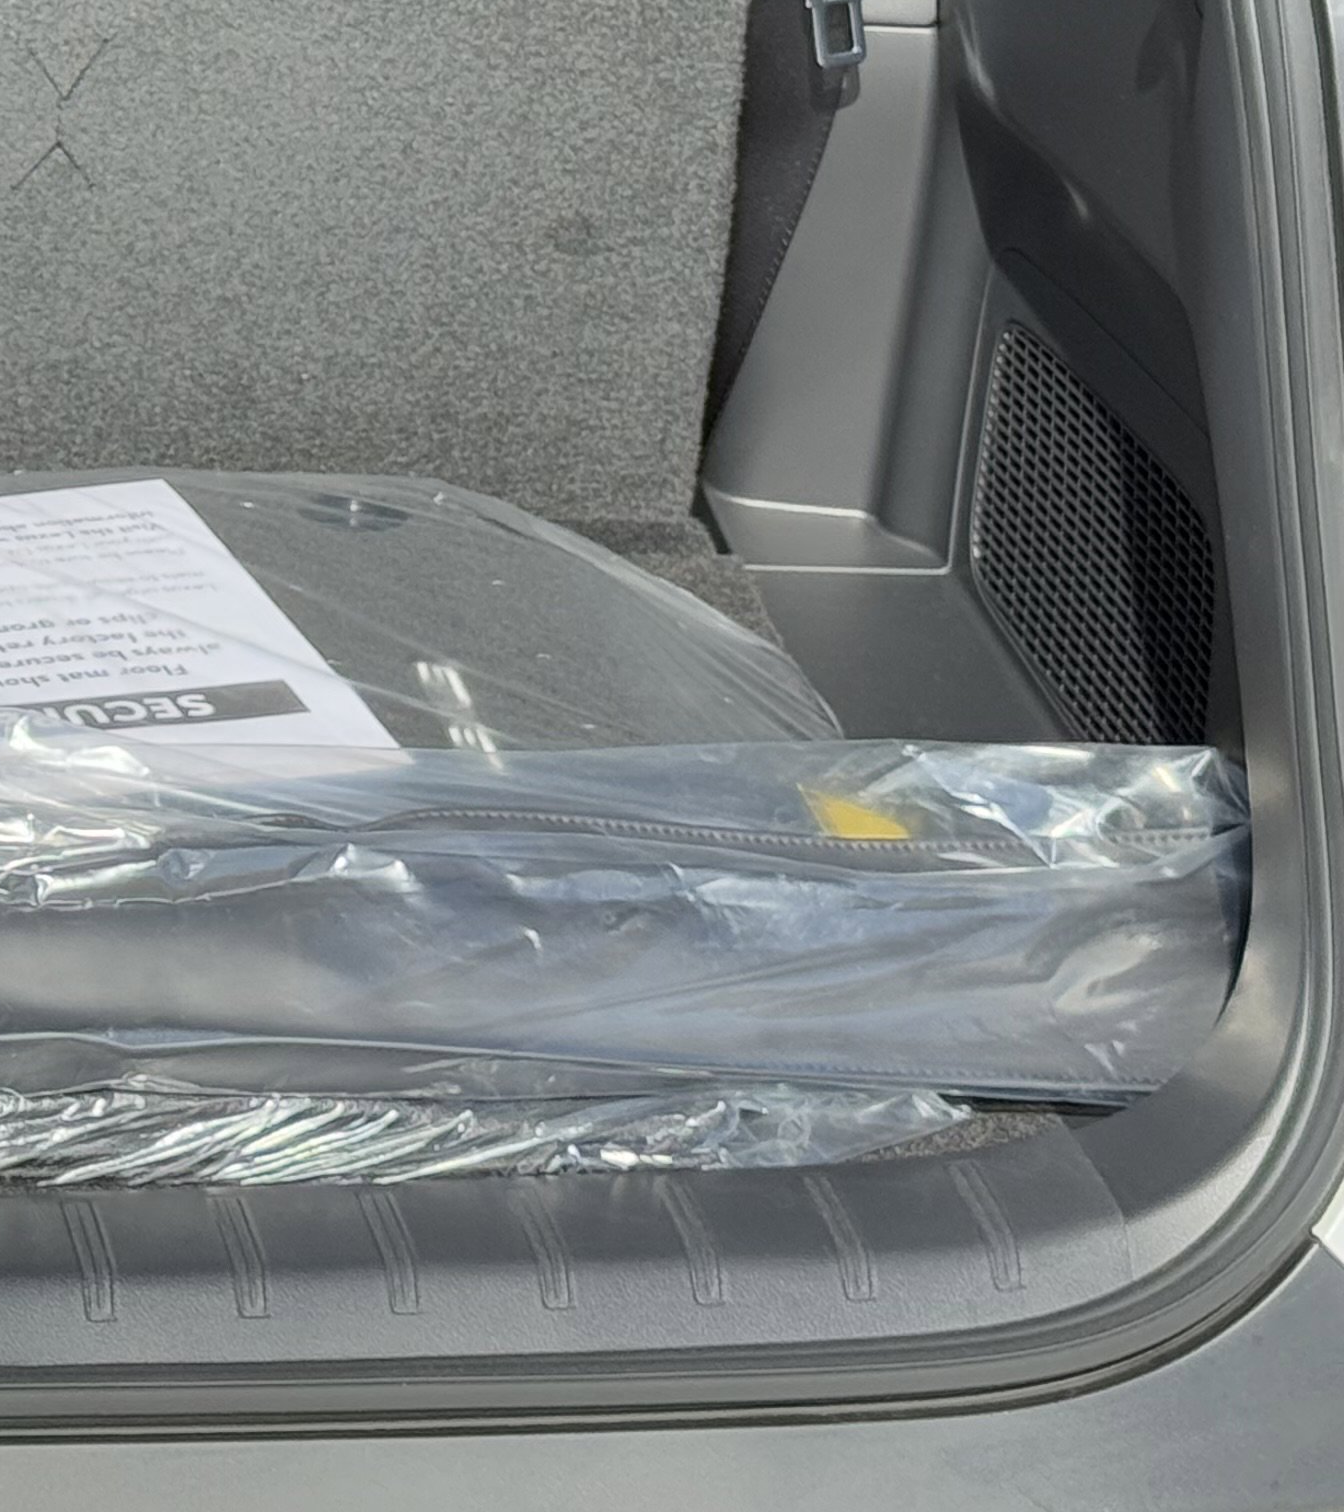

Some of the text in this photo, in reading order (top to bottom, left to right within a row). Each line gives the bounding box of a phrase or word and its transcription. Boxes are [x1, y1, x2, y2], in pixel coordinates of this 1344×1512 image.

[65, 618, 92, 628] or
[97, 613, 157, 625] clips
[43, 633, 138, 647] factory
[144, 630, 186, 640] the
[91, 650, 129, 661] be
[131, 643, 220, 659] always
[56, 669, 110, 683] mat
[120, 664, 189, 677] Floor
